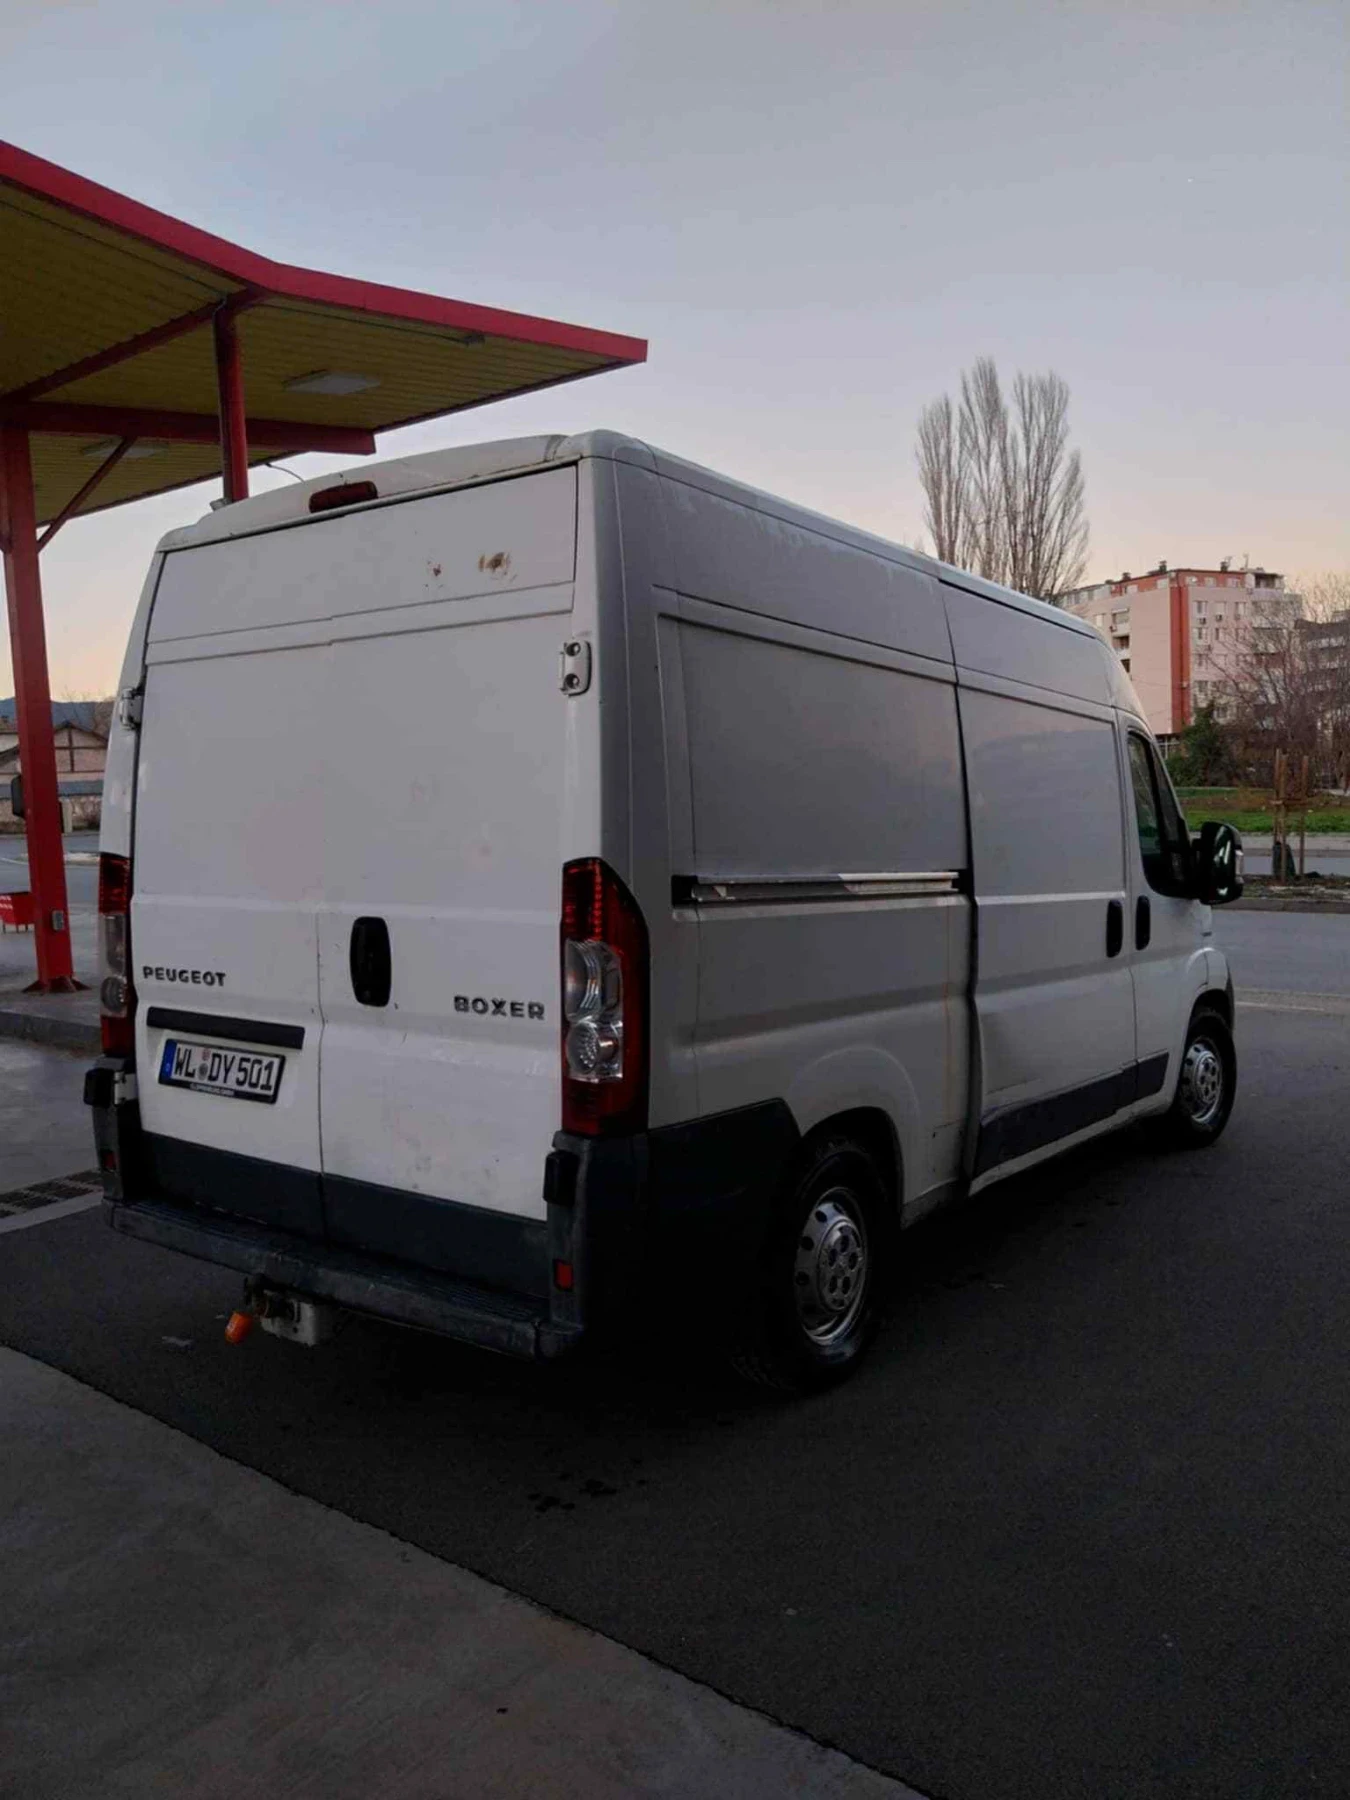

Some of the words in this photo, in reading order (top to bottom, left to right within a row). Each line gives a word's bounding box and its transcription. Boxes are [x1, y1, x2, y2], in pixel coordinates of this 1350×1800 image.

[143, 966, 226, 987] PEUGEOT
[454, 995, 545, 1020] BOXER
[174, 1043, 196, 1078] WL
